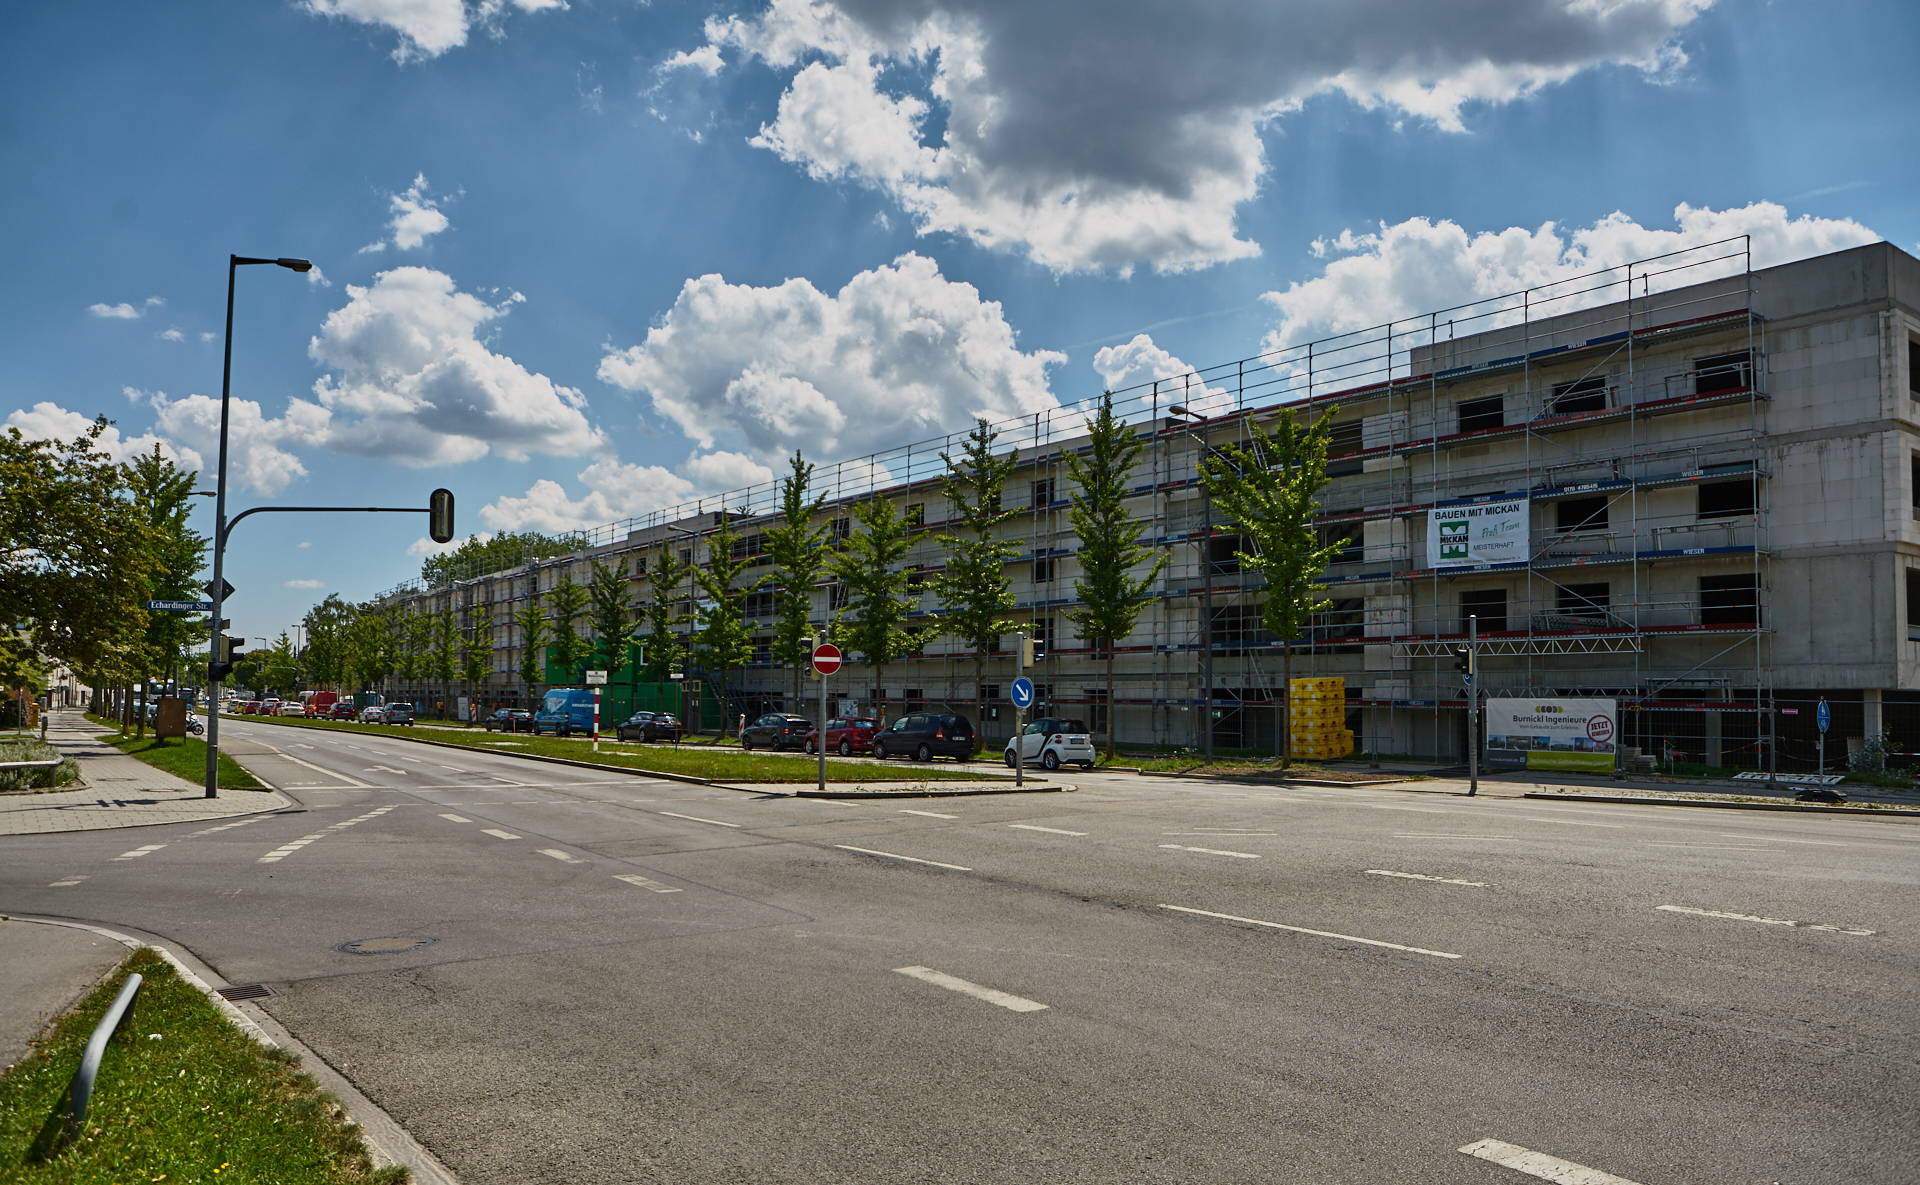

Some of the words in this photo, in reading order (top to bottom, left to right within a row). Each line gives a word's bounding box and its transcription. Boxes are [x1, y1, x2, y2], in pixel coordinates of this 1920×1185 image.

[1681, 469, 1704, 477] WIESER
[1434, 510, 1466, 520] BAUEN
[1468, 508, 1484, 518] MIT
[1485, 503, 1520, 516] MICKAN
[1481, 526, 1498, 539] Profi
[1500, 519, 1520, 533] Team
[1439, 534, 1469, 544] MICKAN
[1472, 541, 1515, 551] MEISTERHAFT
[150, 602, 194, 610] Echardinger
[1512, 714, 1544, 723] Burnickl
[1545, 715, 1587, 725] Ingenieure
[1590, 721, 1609, 731] JETZT
[1529, 757, 1556, 765] Technische
[1557, 758, 1612, 767] Gebäudeausrüstung
